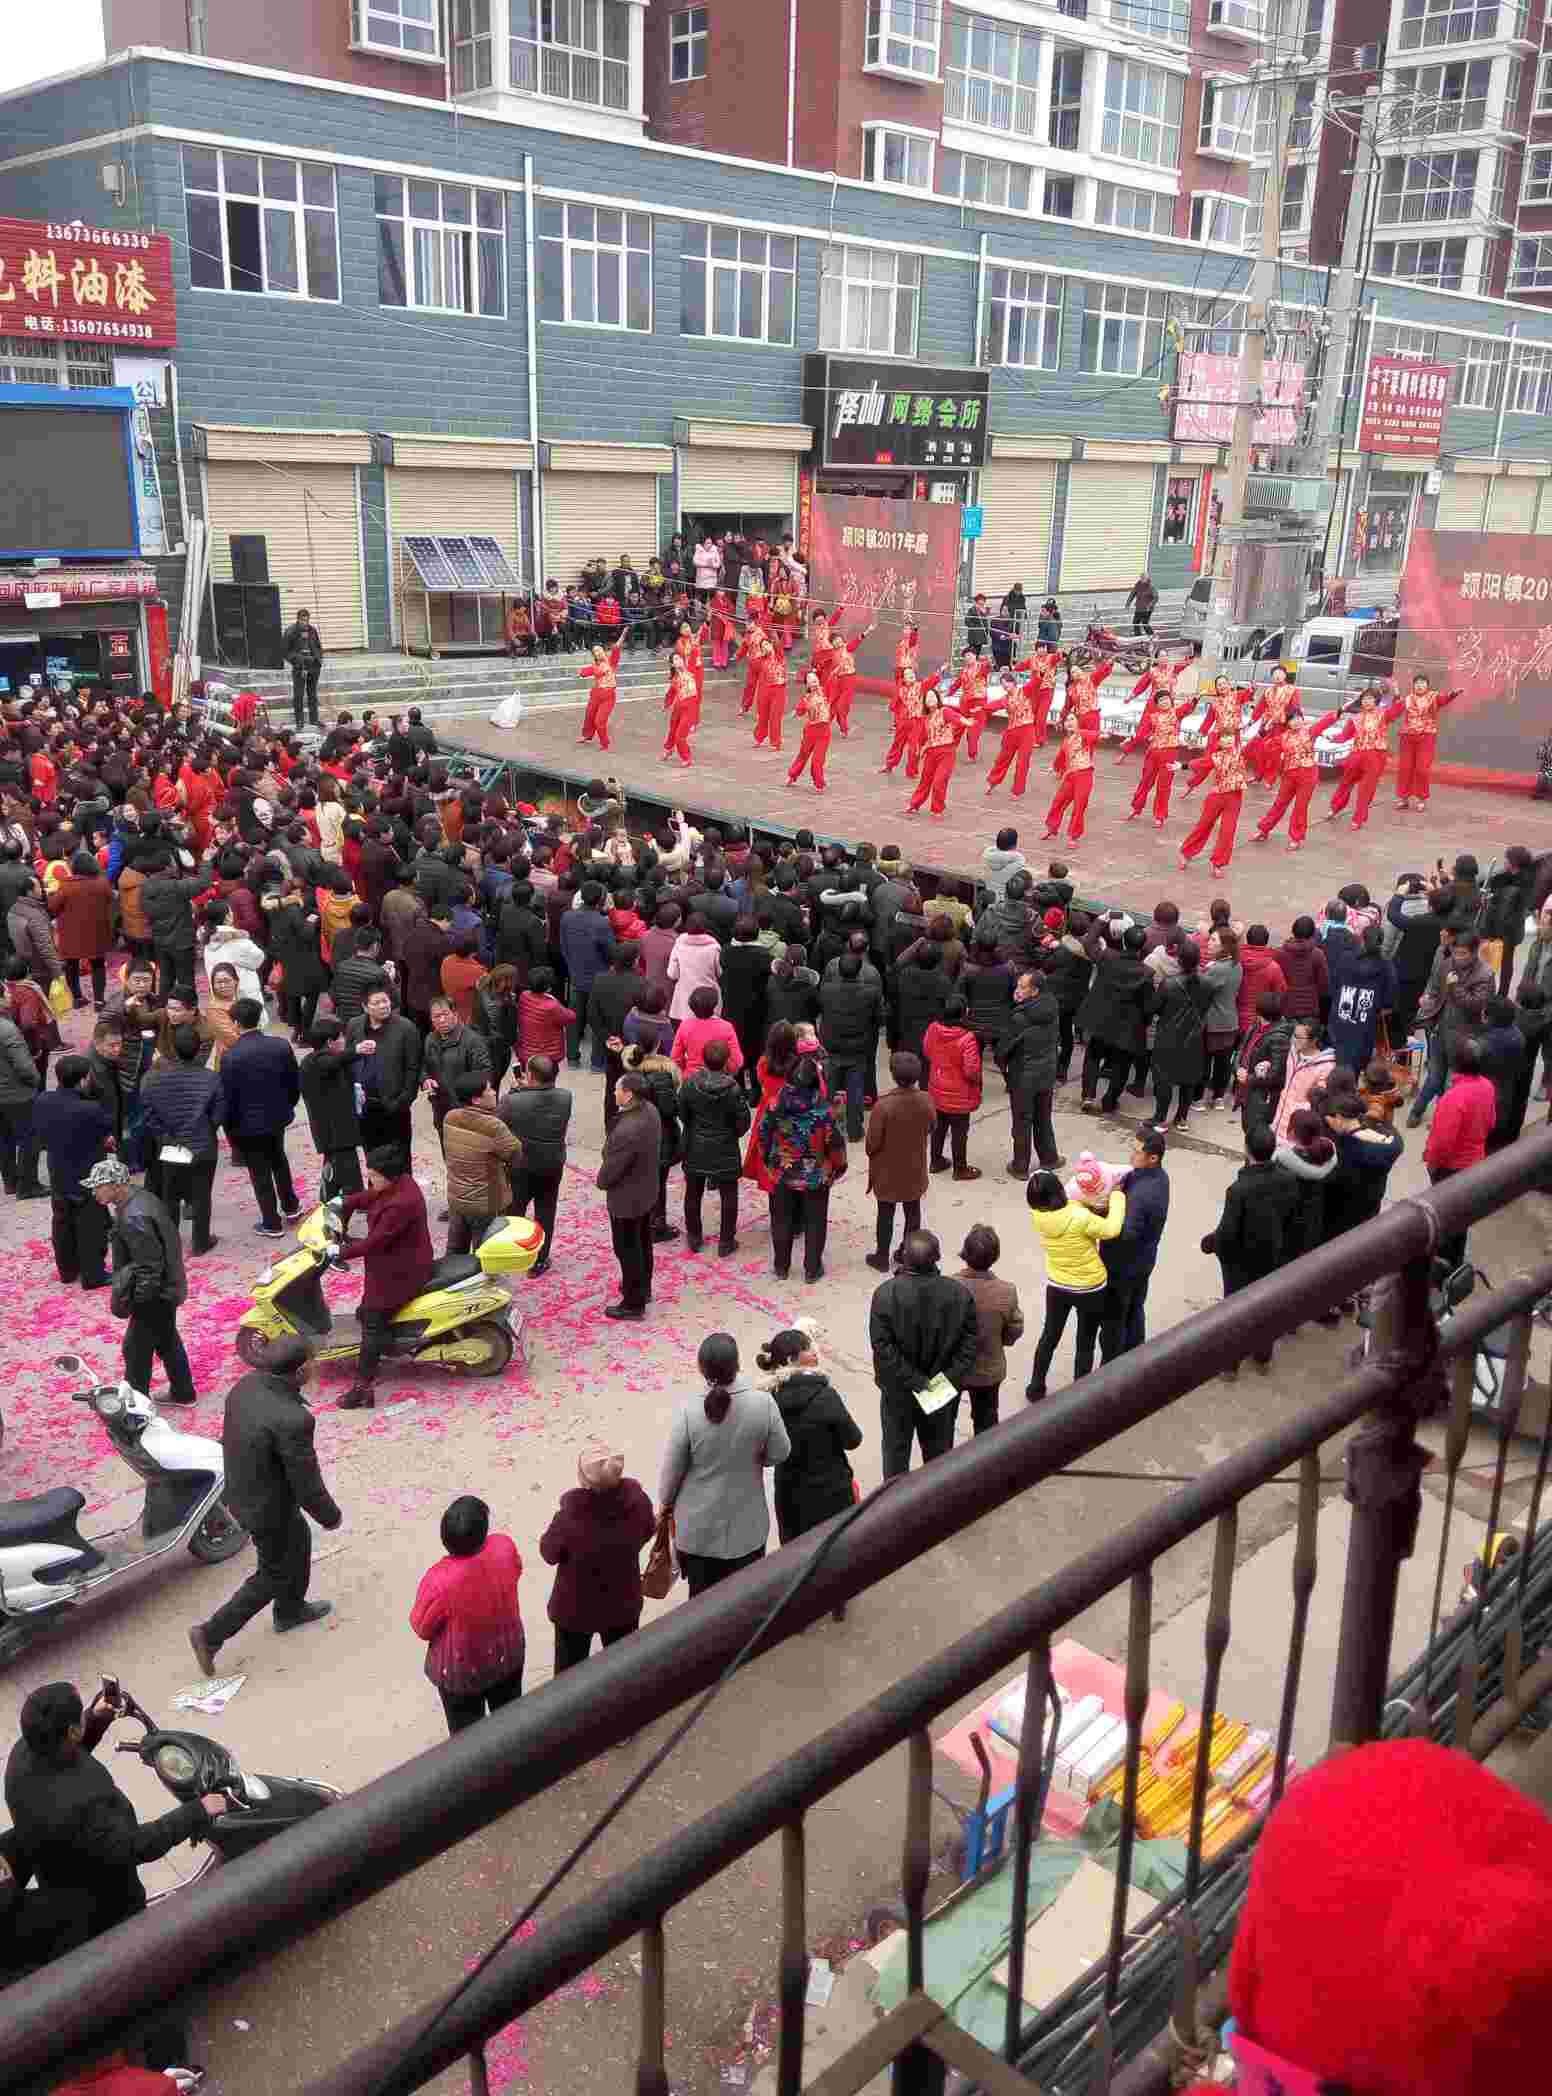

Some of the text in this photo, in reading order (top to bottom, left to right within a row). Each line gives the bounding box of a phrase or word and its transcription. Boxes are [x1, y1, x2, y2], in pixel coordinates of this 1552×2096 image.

[0, 248, 157, 315] 料油漆
[1461, 570, 1552, 603] 颍阳镇20
